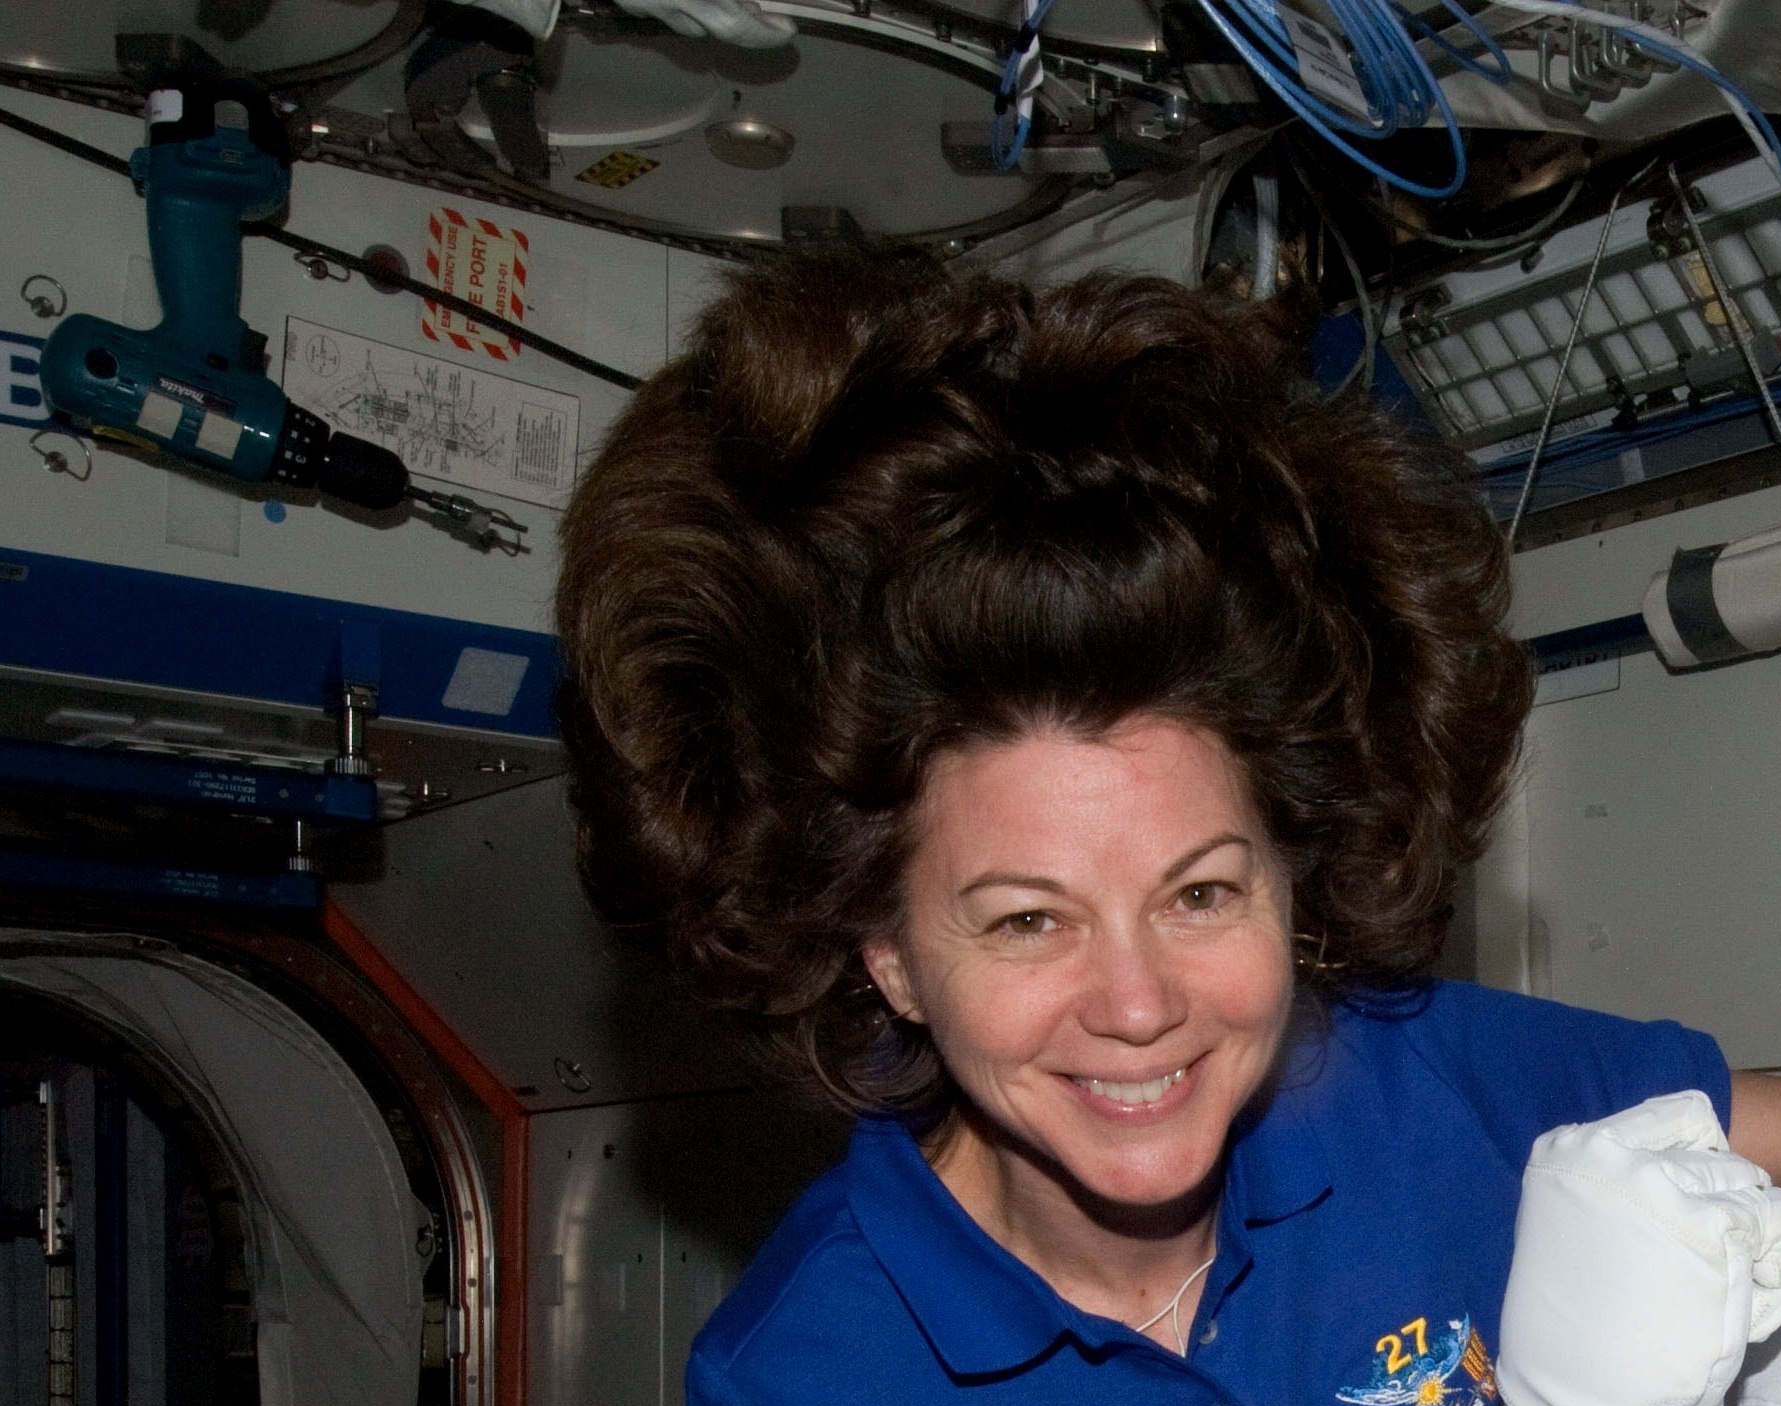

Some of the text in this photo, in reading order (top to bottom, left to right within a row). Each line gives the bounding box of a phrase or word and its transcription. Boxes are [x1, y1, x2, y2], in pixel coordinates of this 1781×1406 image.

[441, 225, 458, 329] EMGENCY USE
[465, 235, 488, 335] FE PORT
[1376, 1317, 1428, 1374] 27
